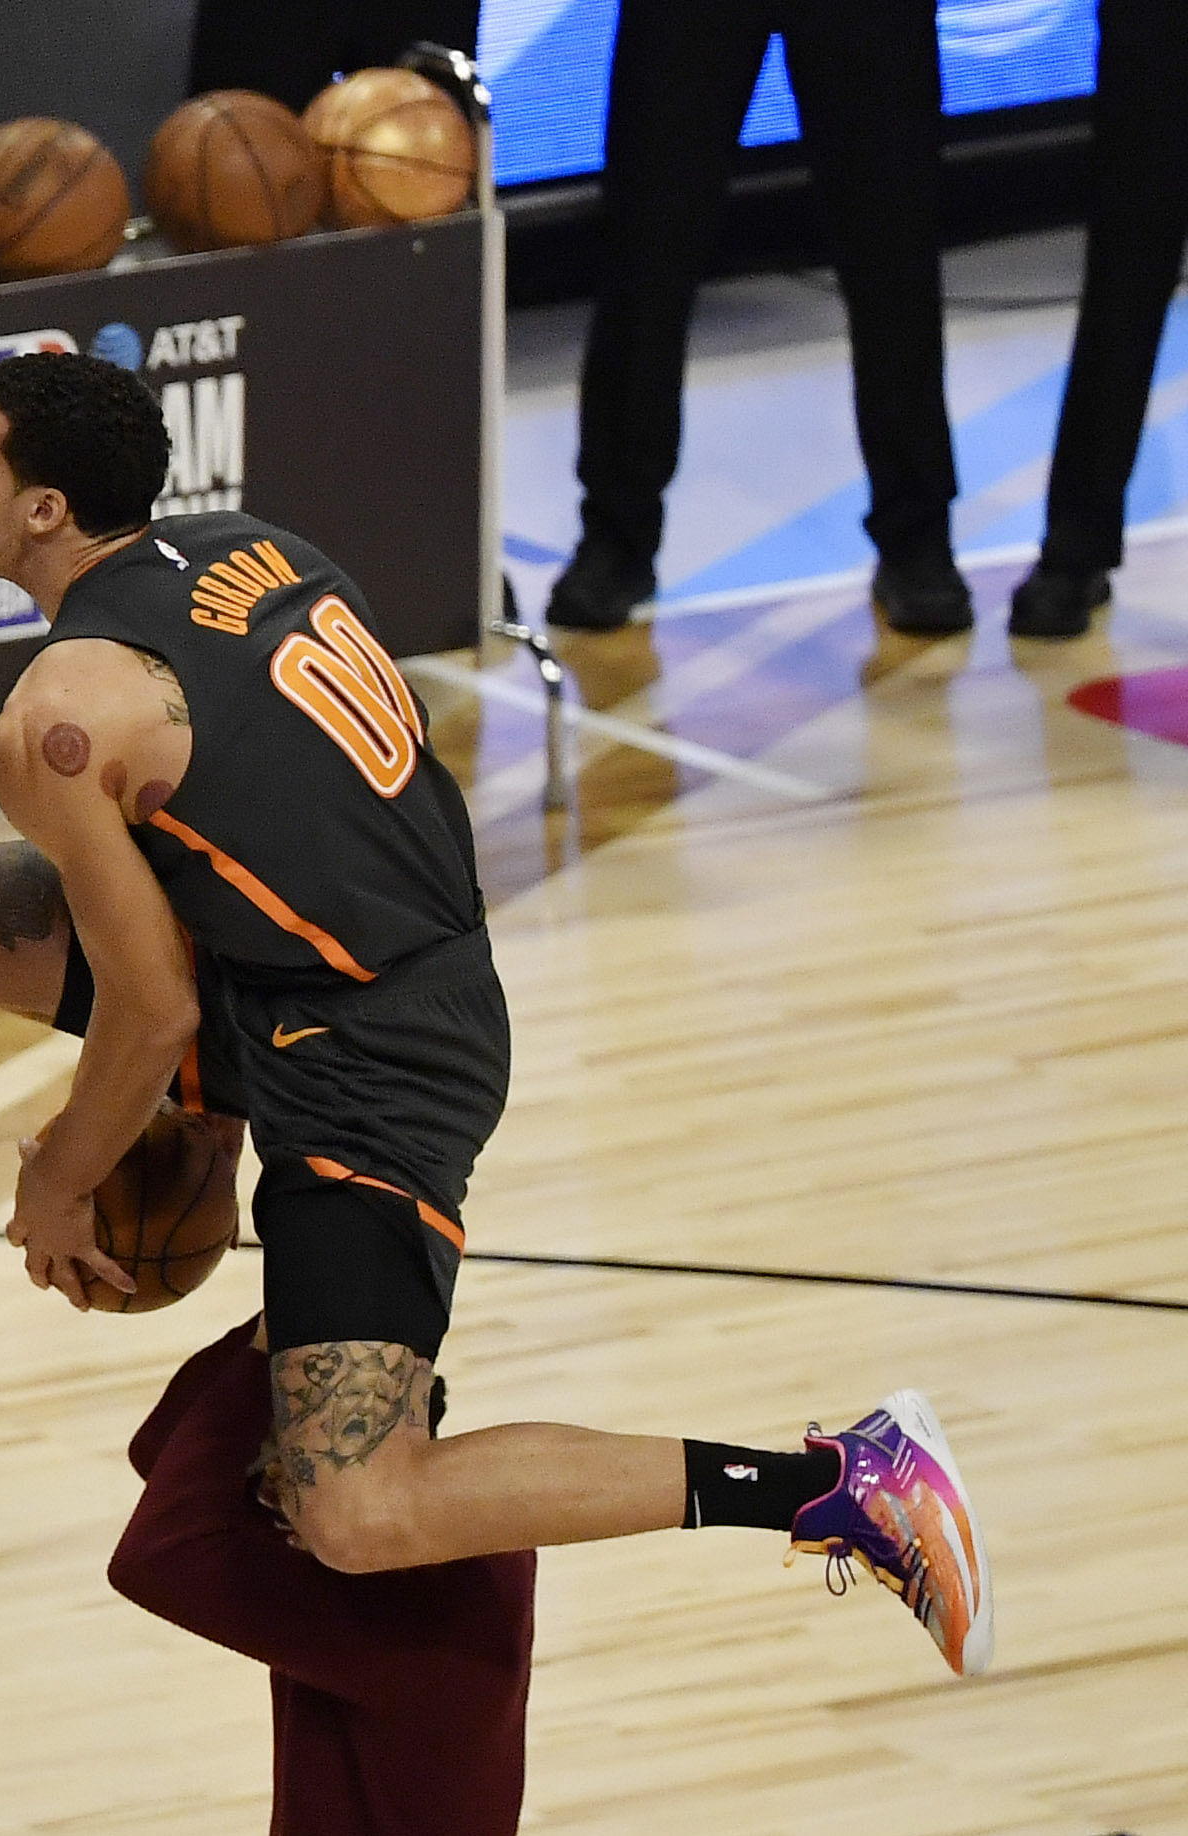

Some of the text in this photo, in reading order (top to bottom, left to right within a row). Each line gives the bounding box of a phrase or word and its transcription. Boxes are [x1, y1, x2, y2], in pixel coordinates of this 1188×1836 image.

[146, 315, 244, 370] AT&T
[190, 540, 302, 636] GORDON
[269, 593, 424, 799] 00
